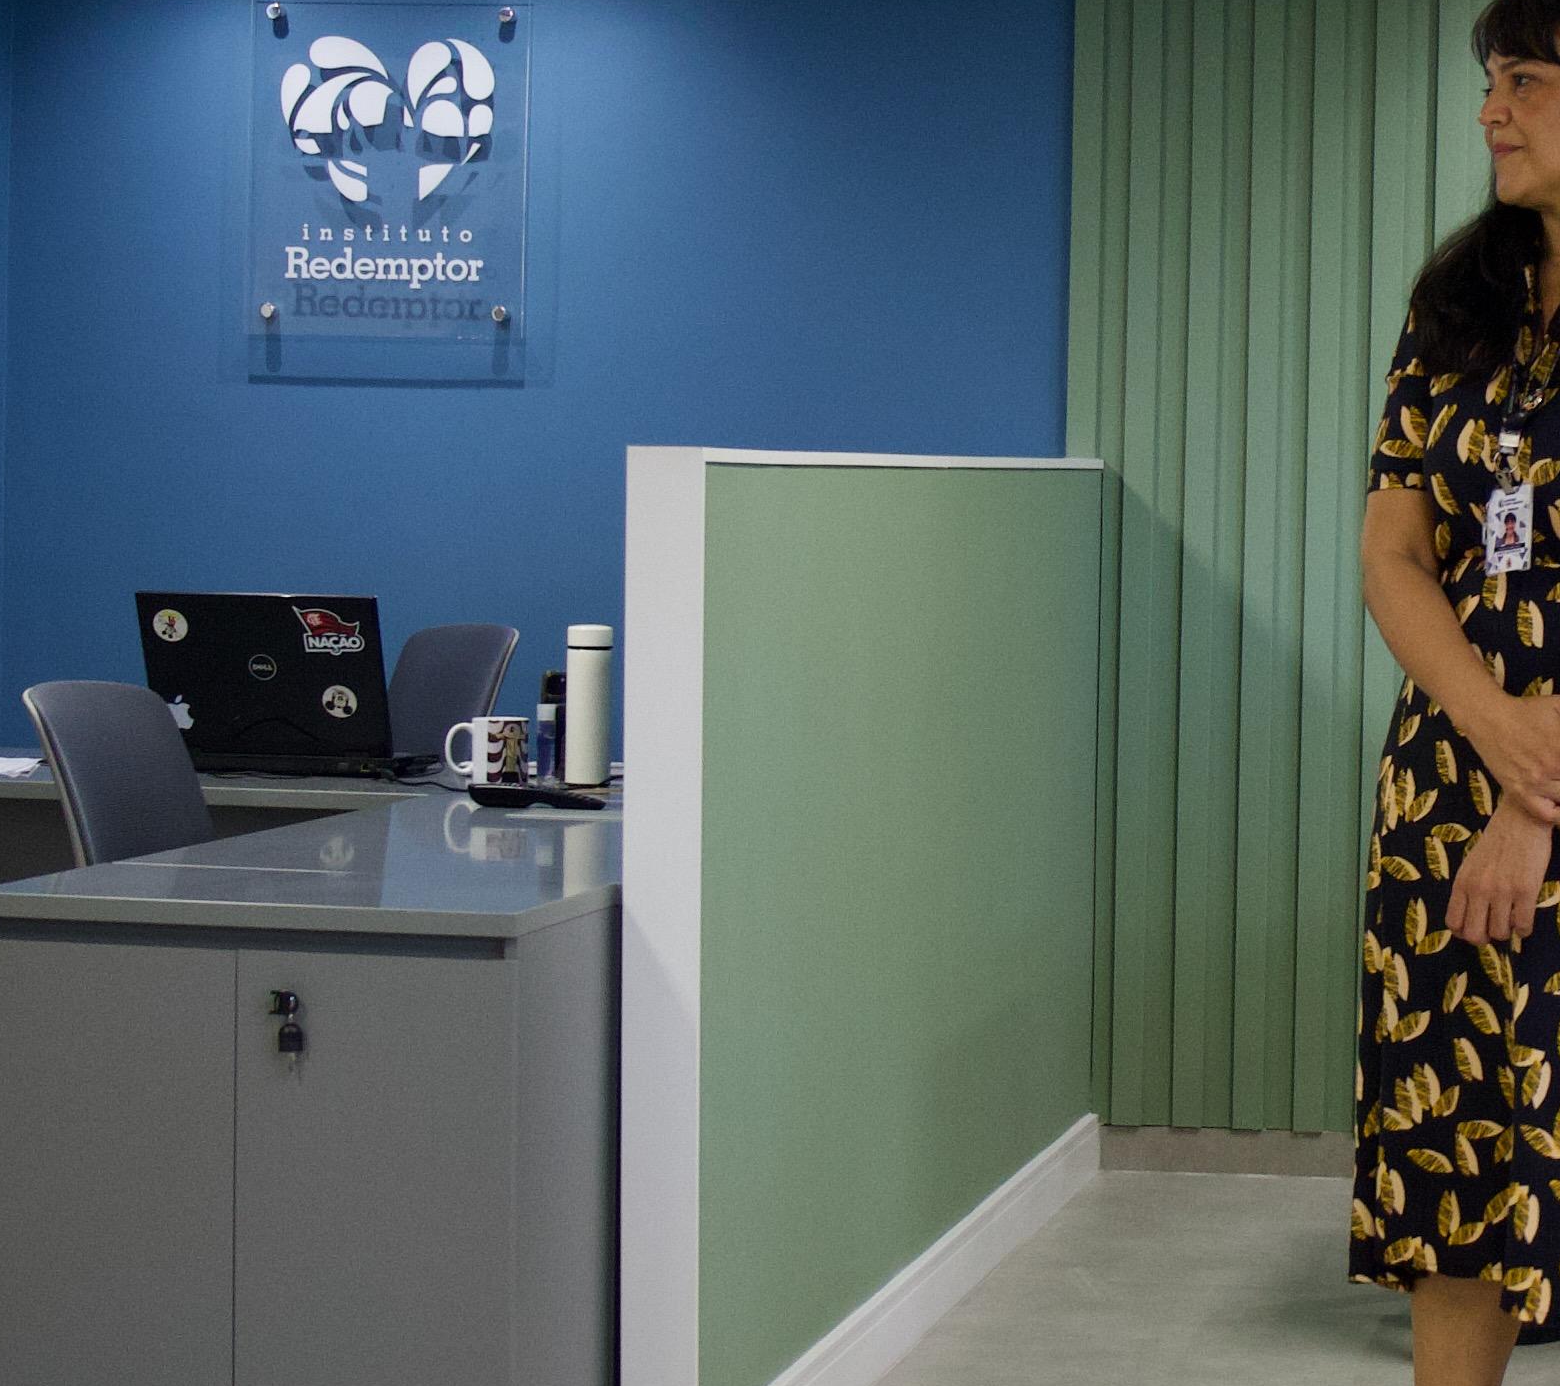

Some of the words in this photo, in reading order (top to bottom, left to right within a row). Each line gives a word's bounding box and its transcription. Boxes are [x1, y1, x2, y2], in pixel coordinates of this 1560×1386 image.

[302, 223, 473, 242] instituto
[284, 246, 484, 289] Redemptor
[307, 634, 361, 653] NAÇÃO
